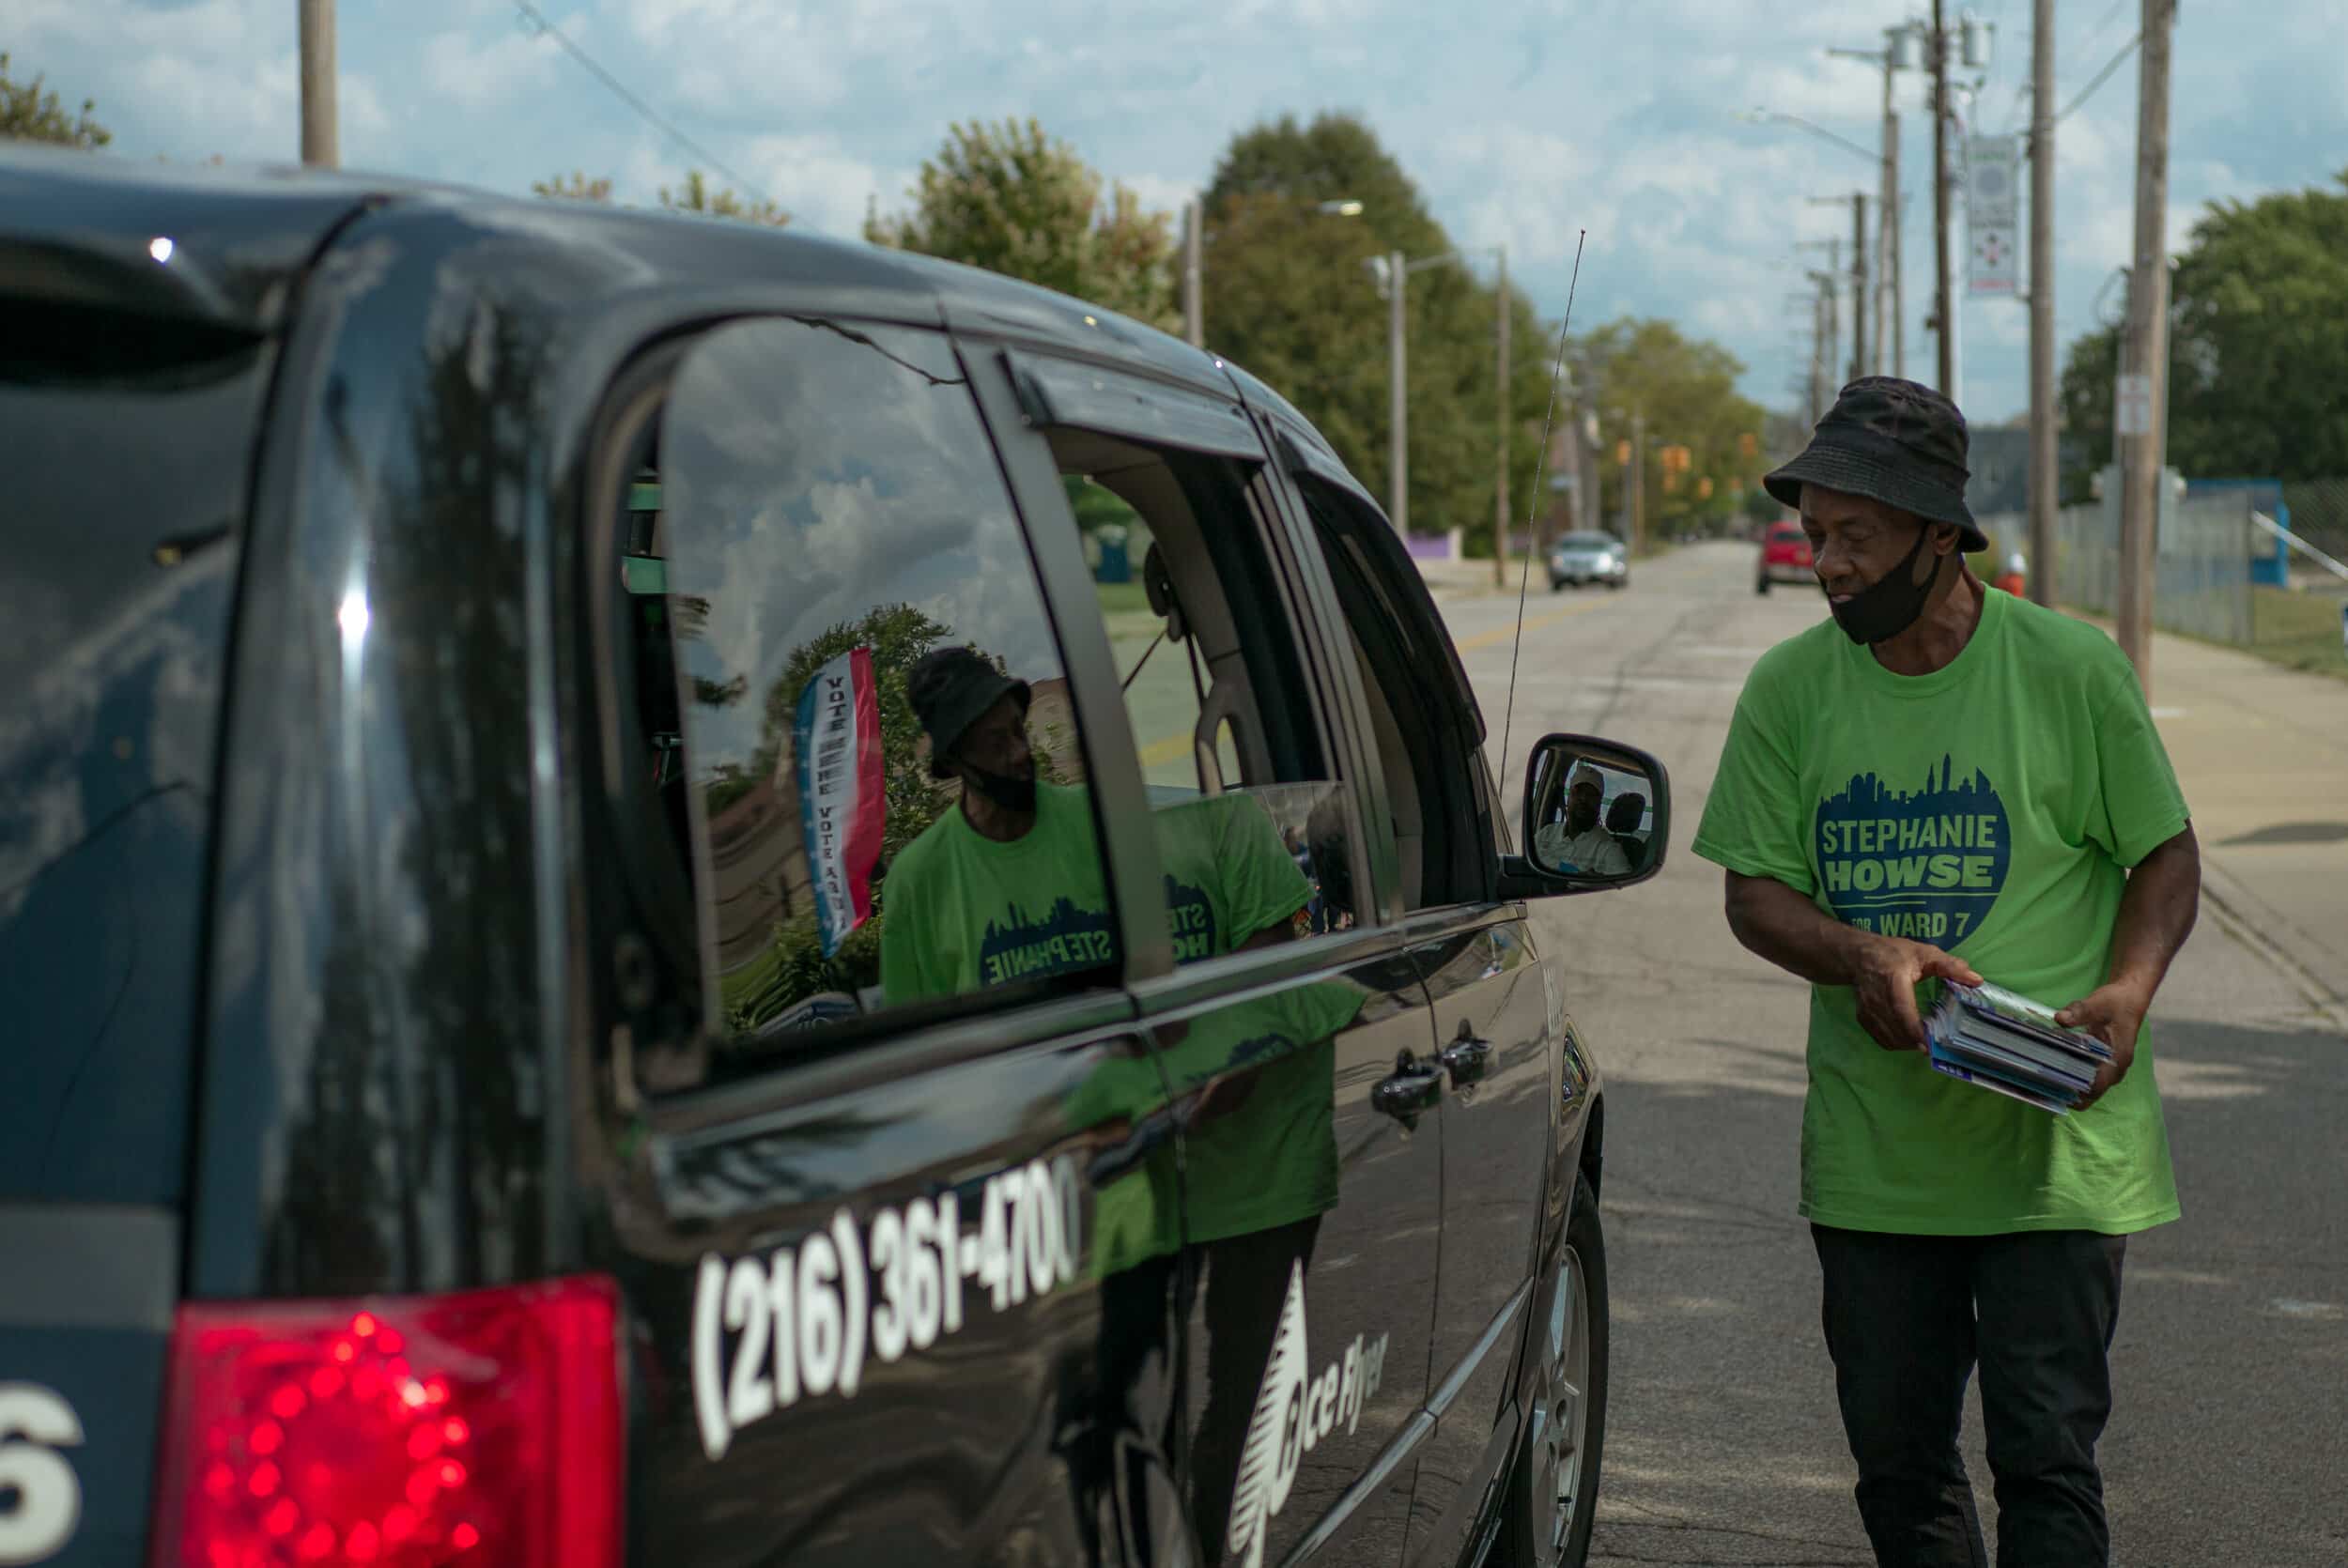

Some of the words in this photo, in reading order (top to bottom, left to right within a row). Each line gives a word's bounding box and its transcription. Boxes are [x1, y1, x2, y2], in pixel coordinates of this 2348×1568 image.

[826, 675, 847, 731] VOTE
[819, 807, 834, 859] VOTE
[1822, 814, 1999, 854] STEPHANIE
[1825, 854, 1995, 892] HOWSE
[1878, 911, 1948, 939] WARD
[1953, 911, 1971, 938] 7
[693, 1209, 868, 1463] (216)
[869, 1154, 1083, 1365] 361-4700
